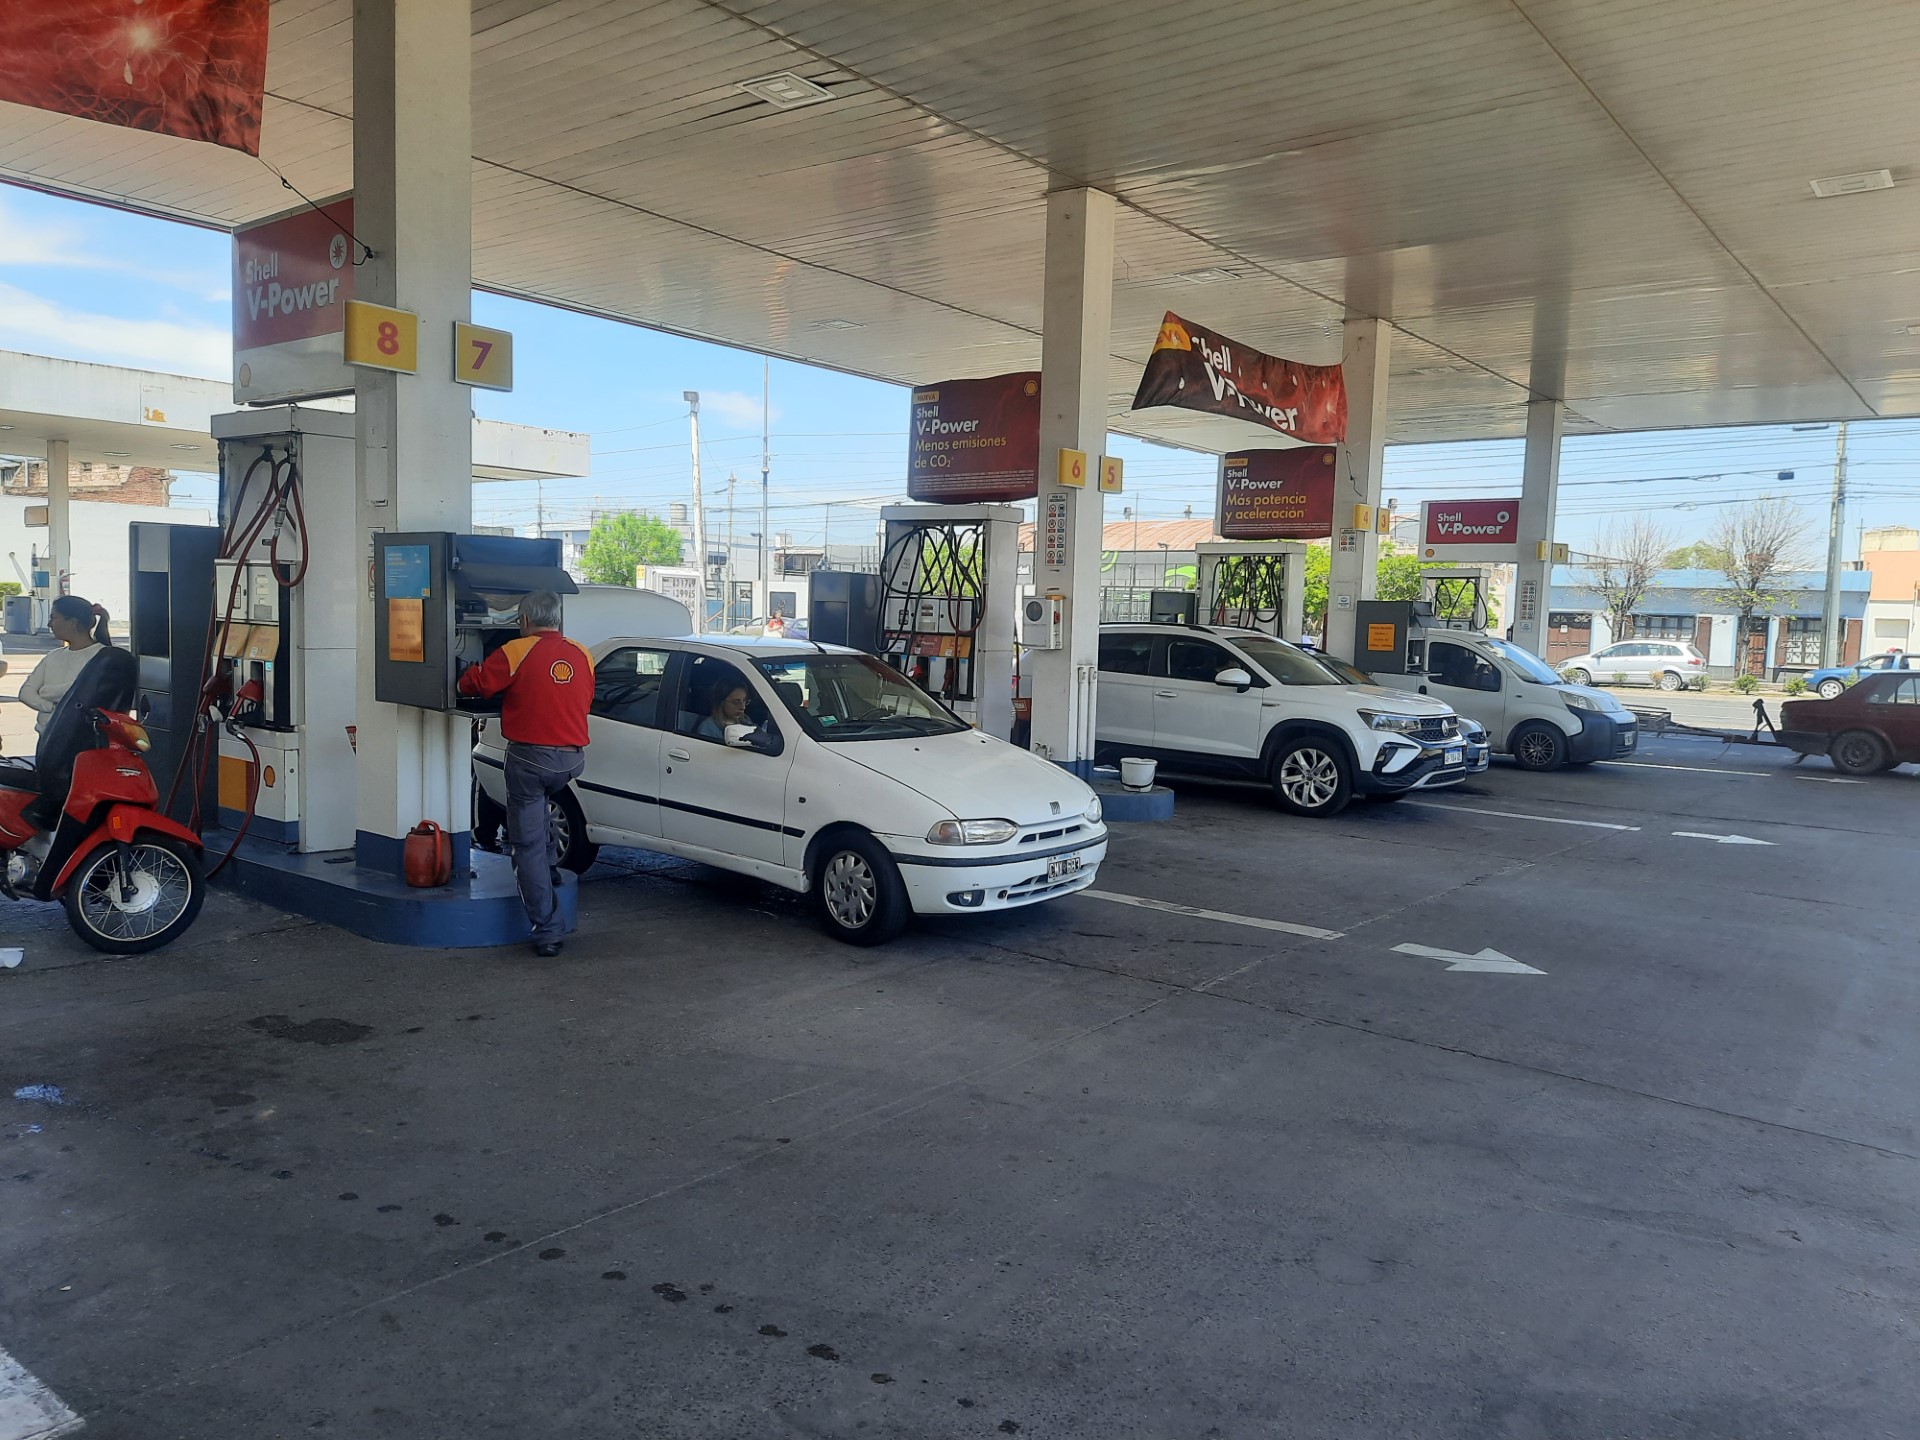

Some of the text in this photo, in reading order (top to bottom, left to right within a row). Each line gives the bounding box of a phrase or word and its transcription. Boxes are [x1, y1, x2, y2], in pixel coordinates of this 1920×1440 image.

[246, 253, 278, 284] Shell
[246, 277, 339, 321] V-Power
[377, 321, 399, 356] 8
[471, 339, 493, 370] 7
[916, 405, 939, 418] Shell
[916, 419, 979, 436] V-Power
[915, 435, 1007, 452] Menos emisiones
[914, 455, 927, 468] de
[1072, 459, 1081, 478] 6
[1107, 466, 1115, 484] 5
[1227, 468, 1248, 478] Shell
[1227, 479, 1283, 491] V-Power
[1225, 491, 1307, 508] Más potencia
[1225, 511, 1233, 523] y
[1363, 510, 1369, 525] 4
[1381, 514, 1387, 528] 3
[1437, 512, 1462, 522] Shell
[1437, 523, 1503, 536] V-Power
